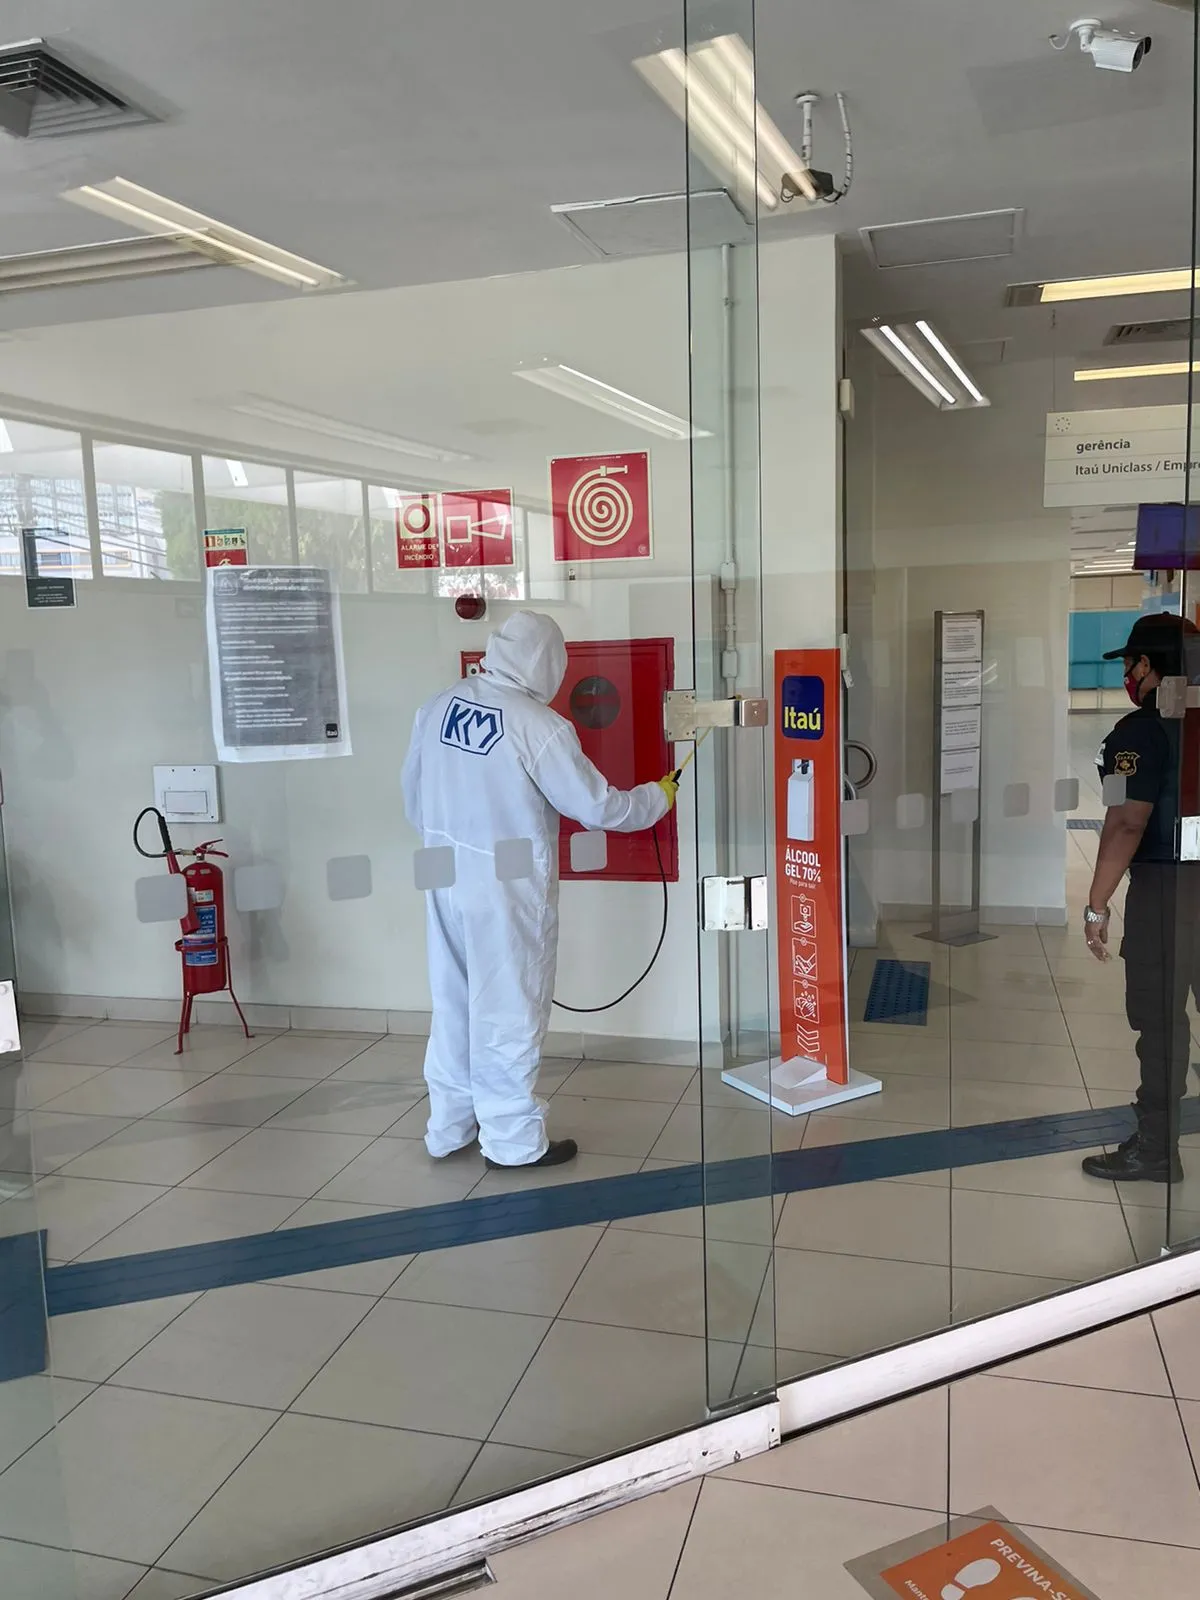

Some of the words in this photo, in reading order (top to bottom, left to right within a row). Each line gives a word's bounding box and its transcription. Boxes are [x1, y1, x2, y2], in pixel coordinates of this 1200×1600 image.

[1076, 439, 1131, 454] gerência
[1075, 464, 1099, 476] Itaú
[1102, 461, 1153, 474] Uniclass
[444, 703, 498, 749] KM
[784, 706, 821, 731] Itaú
[785, 844, 821, 867] ÁLCOOL
[785, 863, 801, 878] GEL
[802, 866, 822, 883] 70%
[990, 1538, 1073, 1600] PREVINA-S
